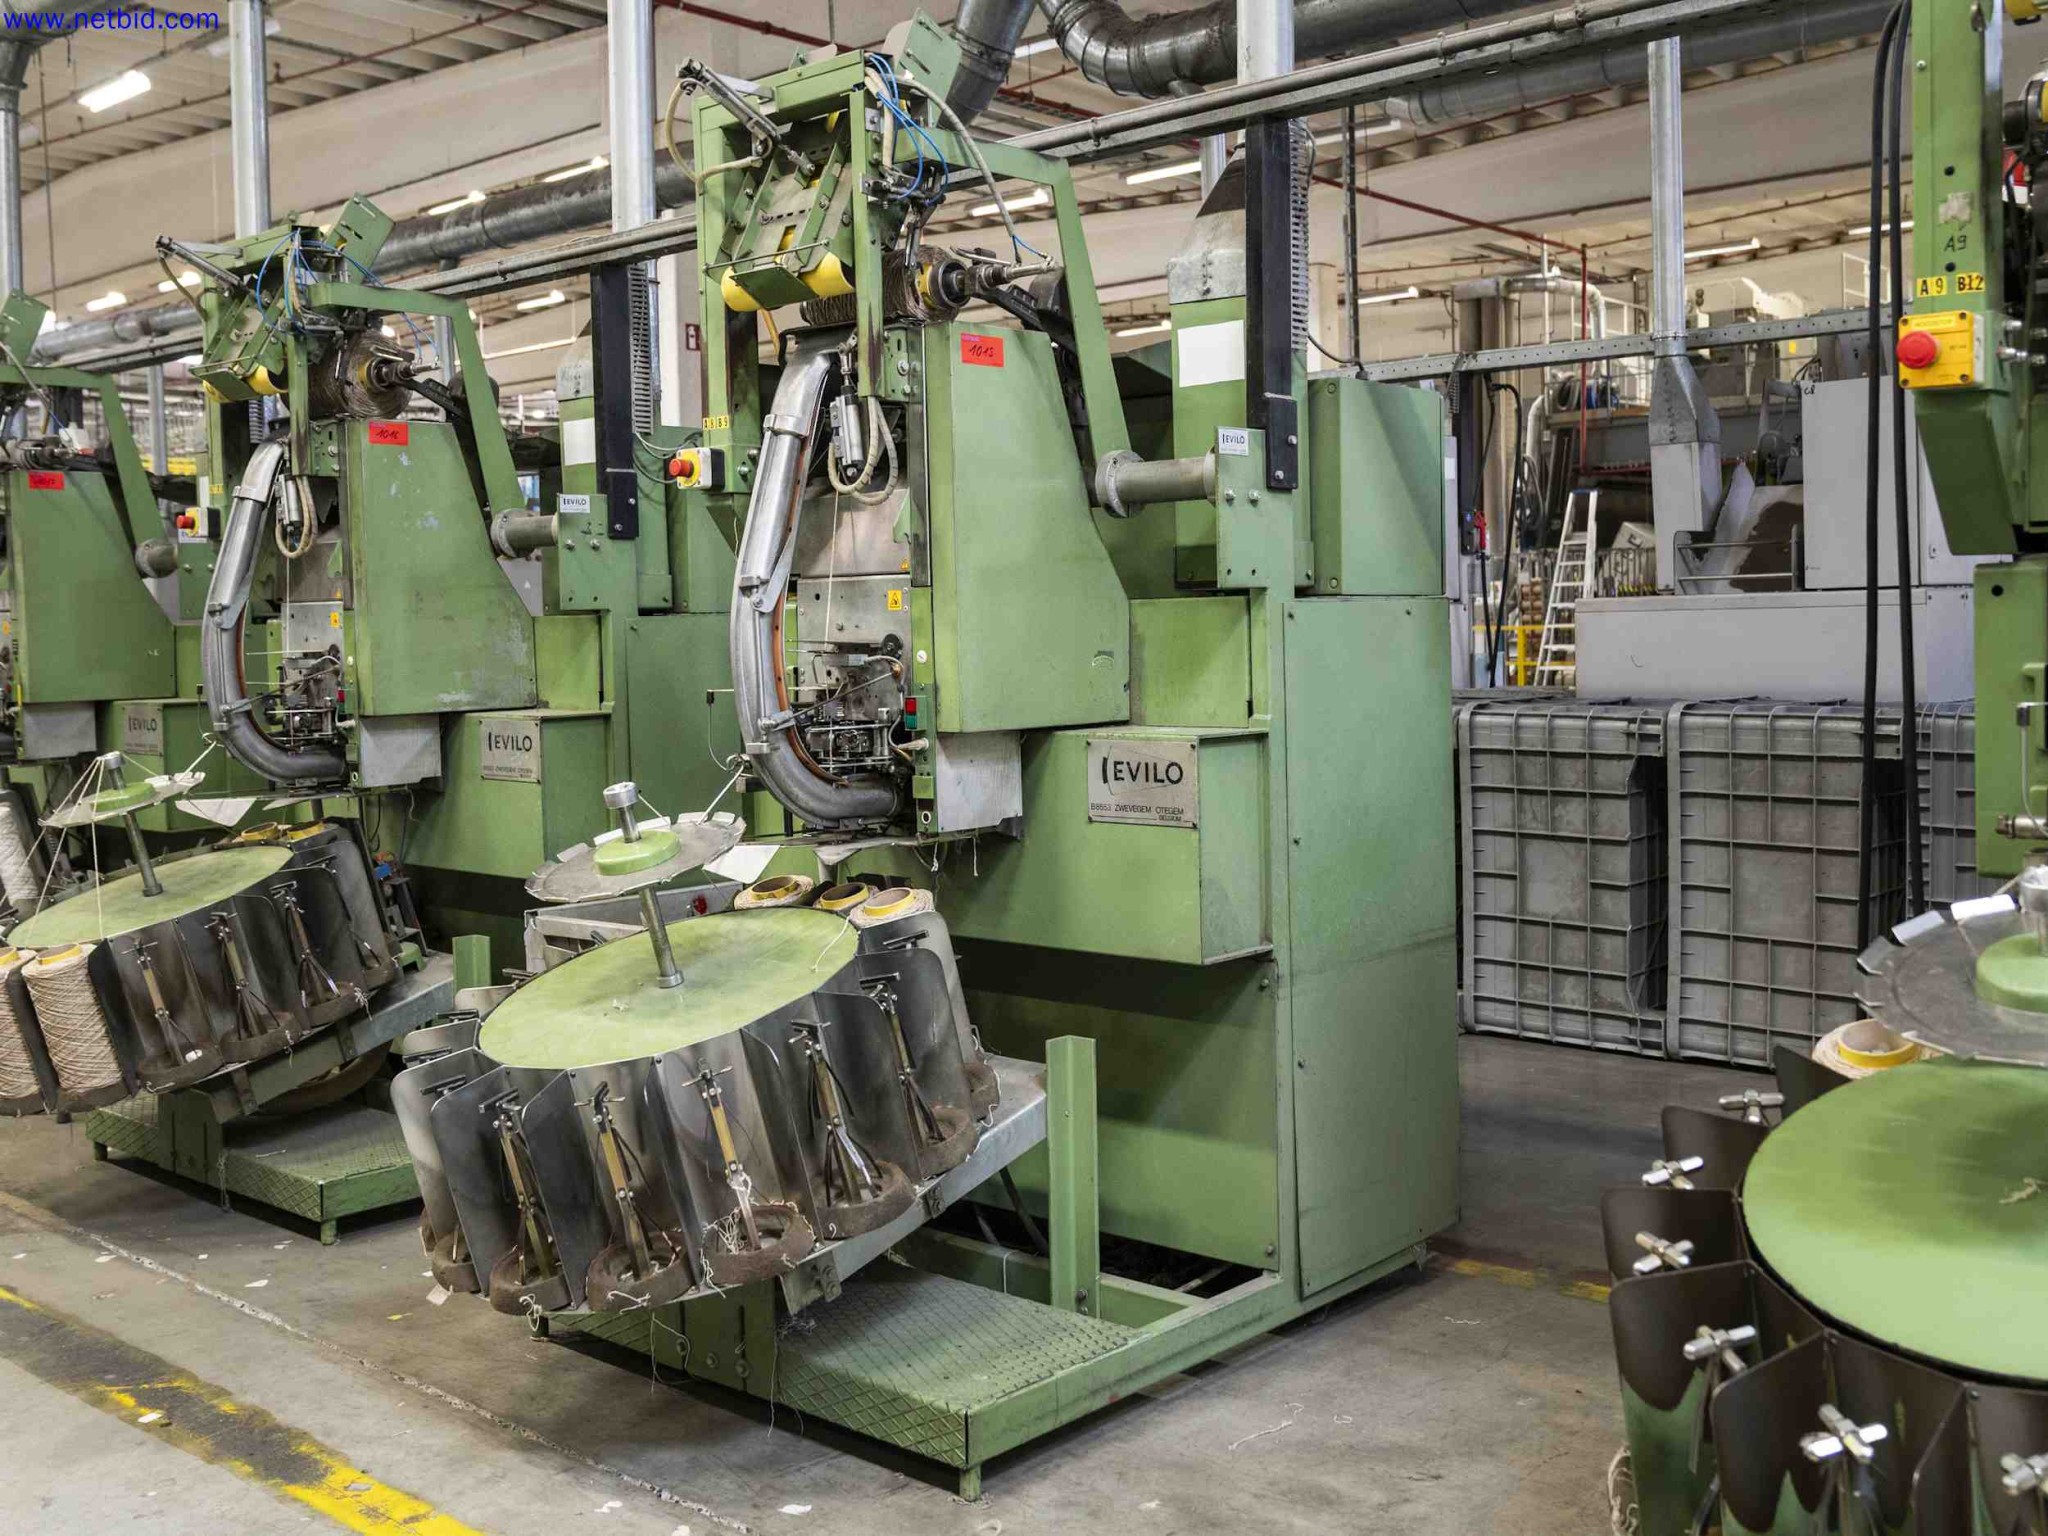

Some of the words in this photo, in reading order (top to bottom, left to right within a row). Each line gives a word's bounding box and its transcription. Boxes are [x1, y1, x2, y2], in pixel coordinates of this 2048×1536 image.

[1943, 235, 1967, 252] A9
[1957, 274, 1984, 292] B12
[1114, 804, 1152, 813] ZWEVEGEM
[1155, 806, 1184, 815] OTEGEM
